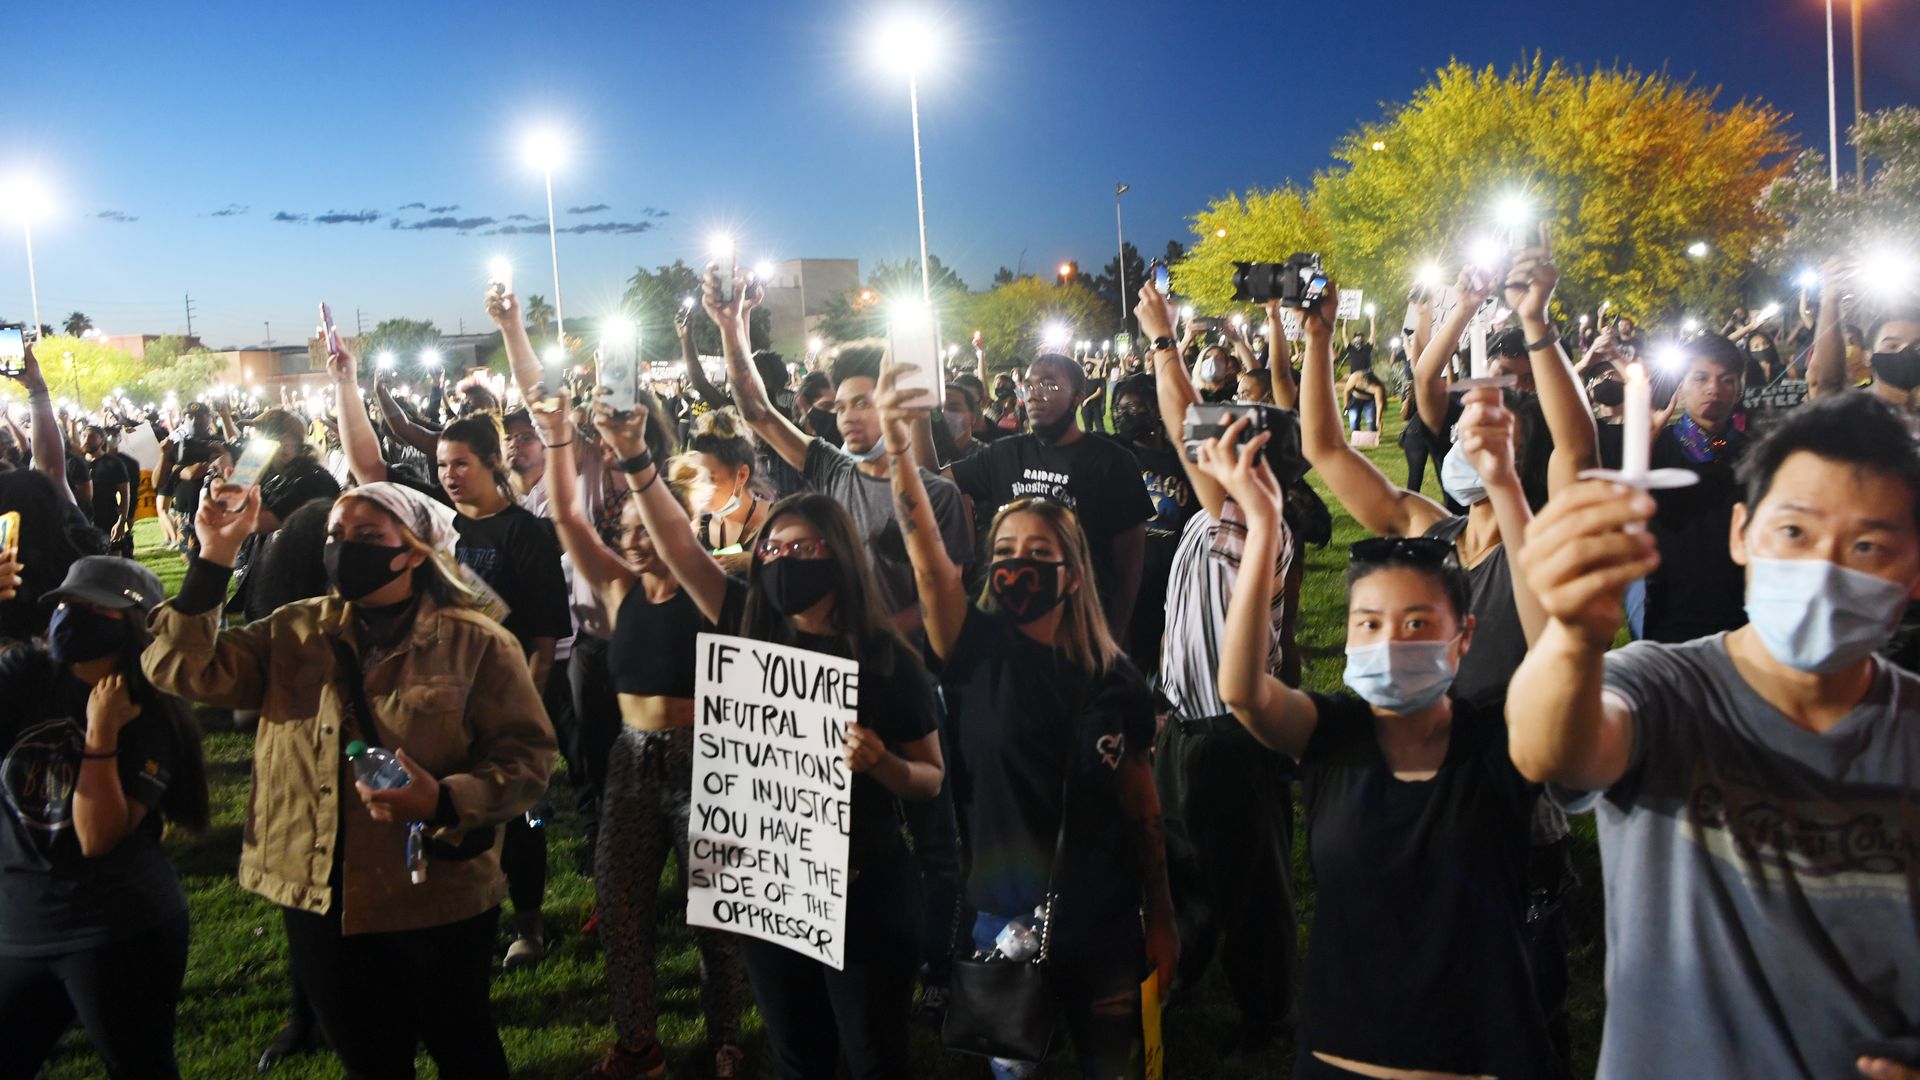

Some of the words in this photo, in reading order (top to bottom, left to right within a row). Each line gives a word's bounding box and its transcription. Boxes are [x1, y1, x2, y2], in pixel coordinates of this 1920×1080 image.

[1023, 468, 1069, 485] RAIDERS
[707, 642, 740, 683] IF
[703, 694, 807, 739] NEUTRAL
[824, 716, 848, 749] IN
[699, 732, 846, 791] SITUATIONS
[697, 803, 747, 839] YOU
[760, 816, 813, 852] HAVE
[703, 772, 738, 796] OF
[752, 778, 851, 837] INJUSTICE
[694, 838, 790, 879] CHOSEN
[800, 858, 843, 898] THE
[691, 869, 756, 898] SIDE
[764, 882, 796, 906] OF
[802, 893, 837, 922] THE
